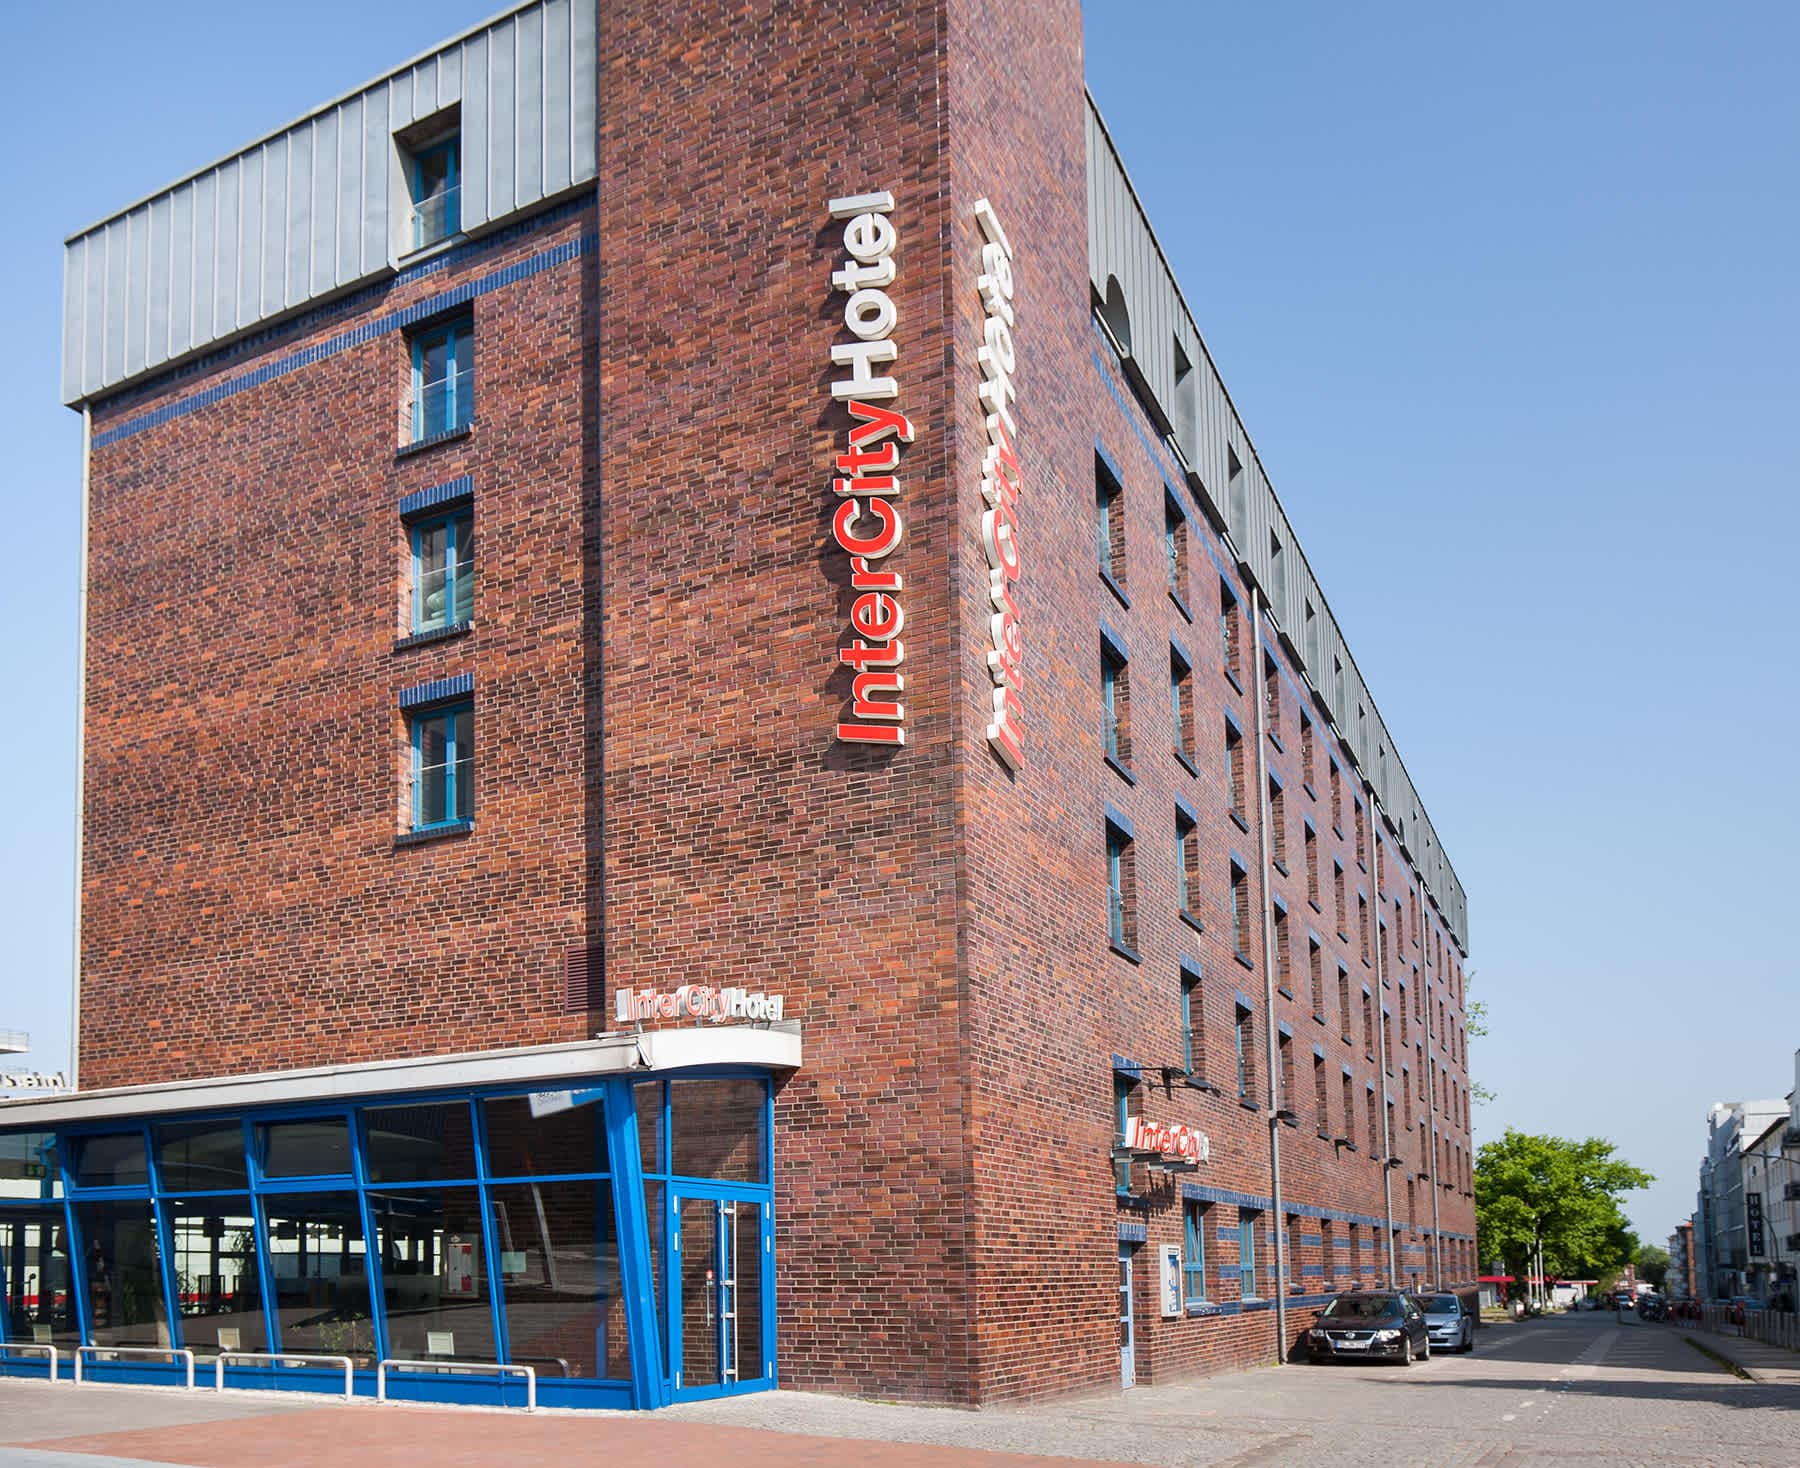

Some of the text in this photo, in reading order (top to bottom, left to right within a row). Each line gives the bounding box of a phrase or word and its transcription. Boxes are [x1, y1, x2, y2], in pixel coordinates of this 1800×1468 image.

[829, 191, 914, 745] InterCityHotel
[974, 198, 1025, 770] InterCityHotel
[616, 984, 784, 1022] InterCityHotel
[1125, 1116, 1209, 1165] InterCity
